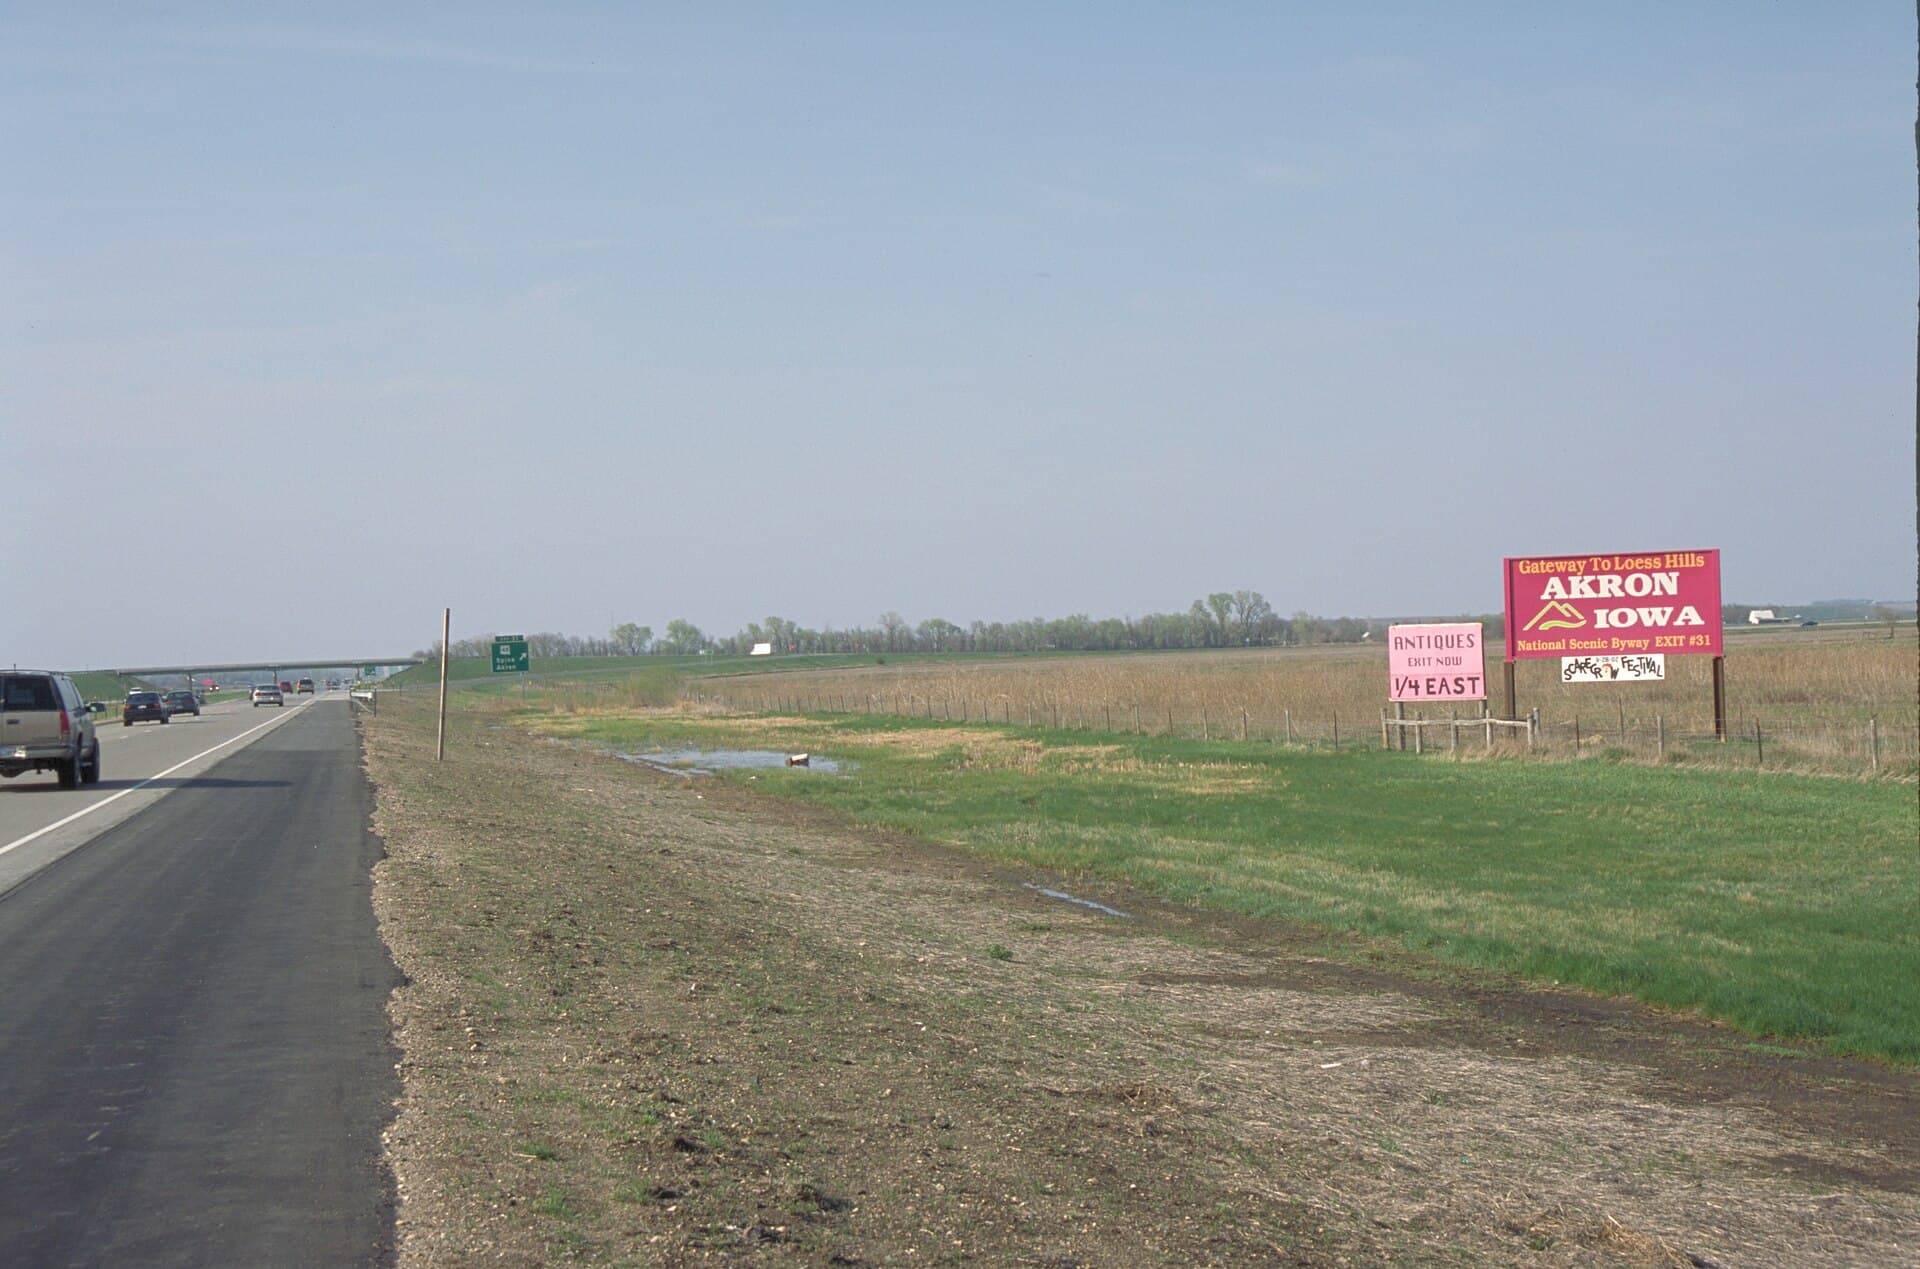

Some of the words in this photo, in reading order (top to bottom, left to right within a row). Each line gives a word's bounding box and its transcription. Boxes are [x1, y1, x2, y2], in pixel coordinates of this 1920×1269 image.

[1519, 560, 1587, 576] Gateway
[1590, 557, 1611, 571] To
[1614, 557, 1662, 571] Loess
[1664, 553, 1705, 568] Hills
[1540, 572, 1680, 600] AKRON
[1593, 606, 1705, 628] IOWA
[1394, 633, 1475, 650] ANTIQUES
[1517, 639, 1566, 651] National
[1569, 638, 1608, 650] Scenic
[1611, 637, 1650, 651] Byway
[1655, 636, 1686, 647] EXIT
[1689, 634, 1711, 646] #31
[1408, 657, 1432, 667] EXIT
[1436, 656, 1462, 666] NOW
[1621, 656, 1663, 677] FESTIVAL
[1395, 676, 1420, 697] 1/4
[1426, 677, 1480, 695] EAST
